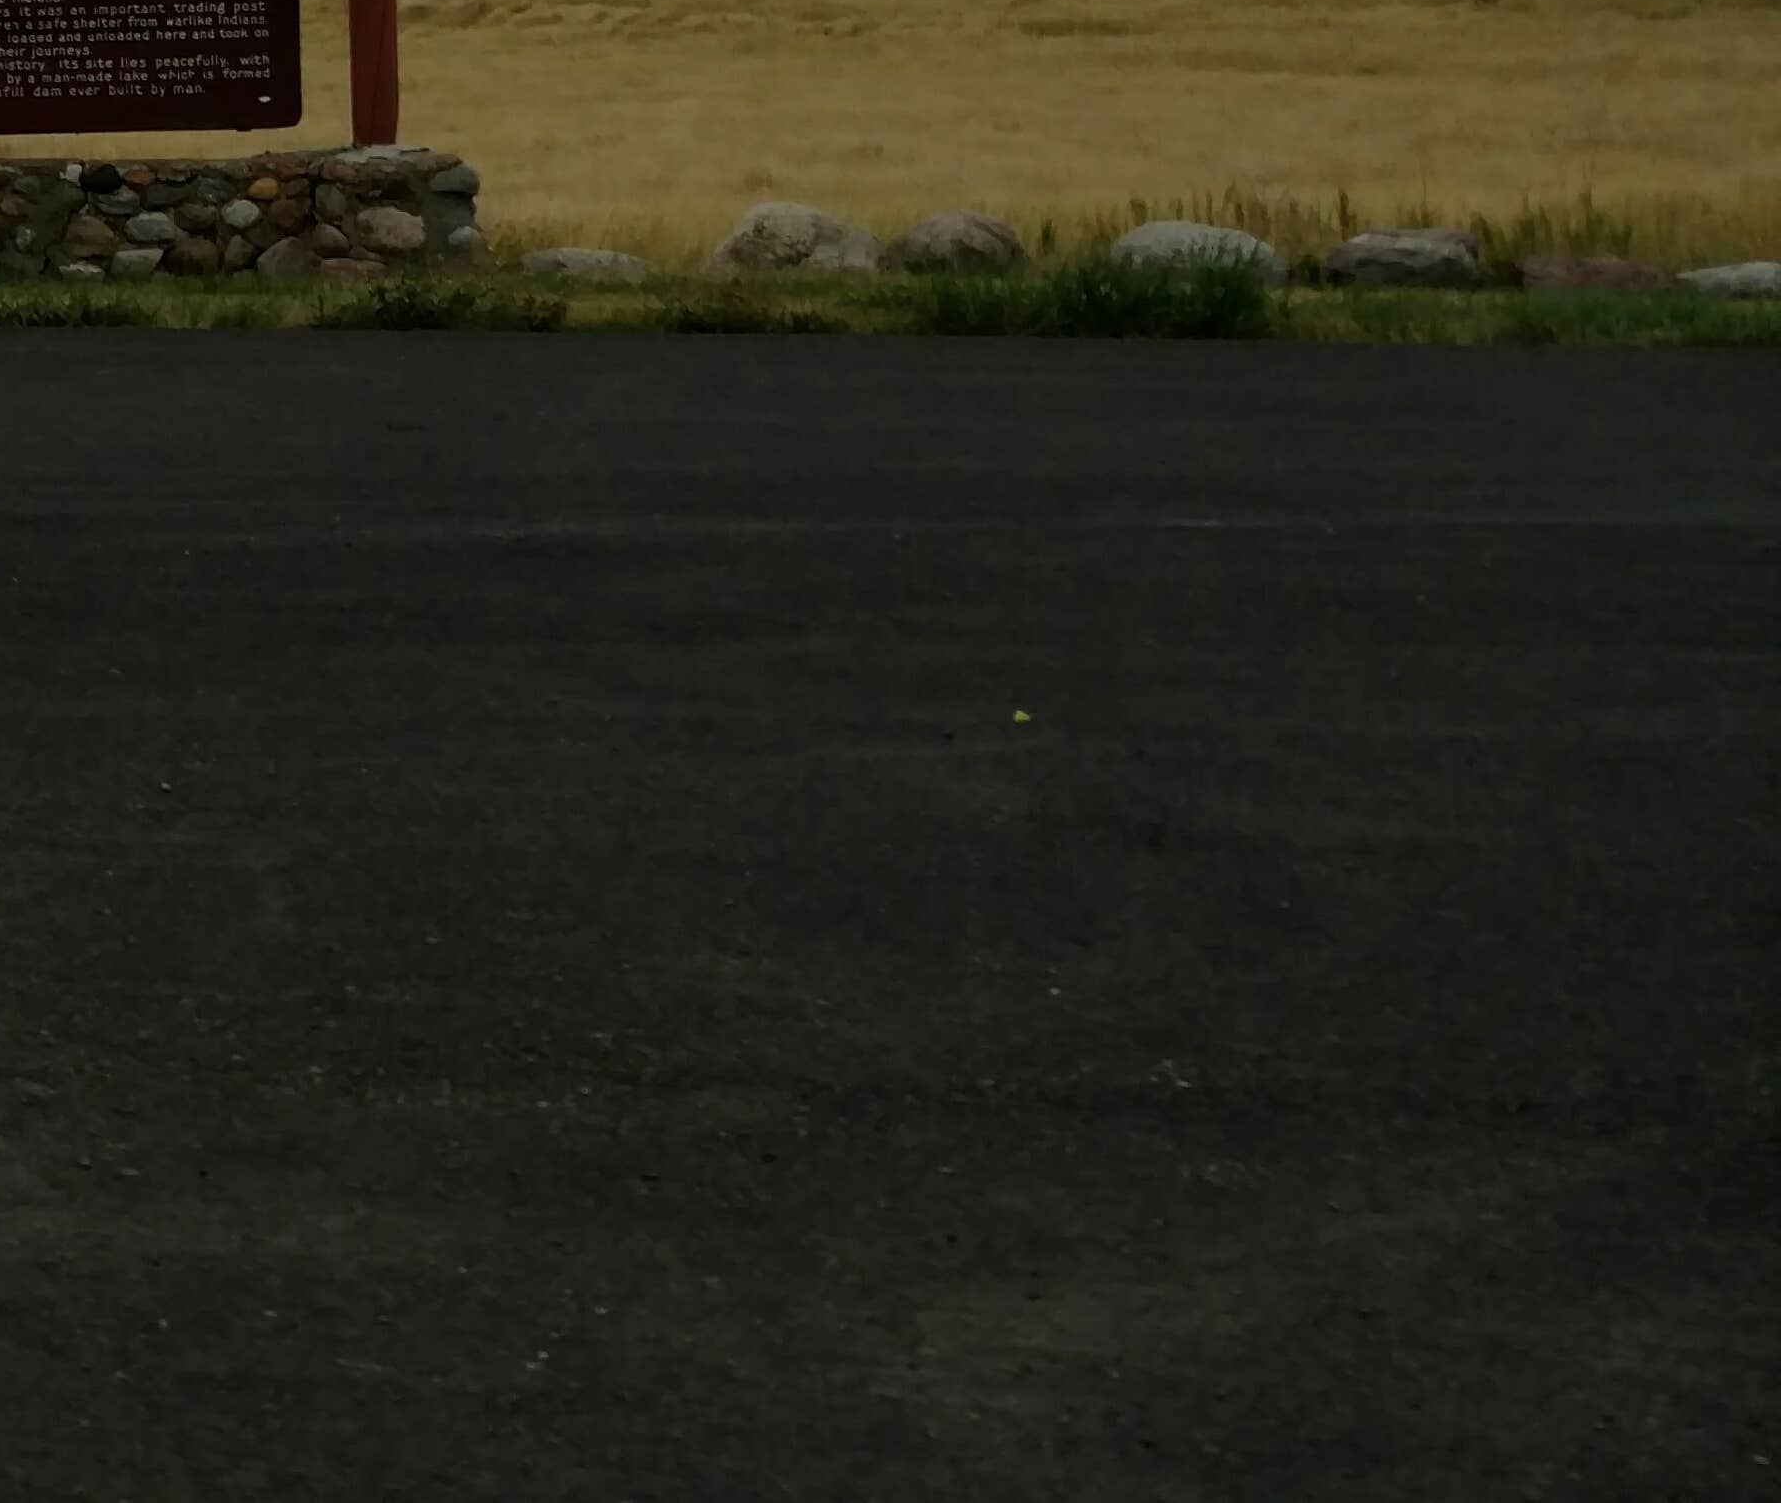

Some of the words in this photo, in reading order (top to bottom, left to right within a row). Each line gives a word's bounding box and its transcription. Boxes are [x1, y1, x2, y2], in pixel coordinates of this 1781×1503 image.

[37, 6, 62, 17] was
[70, 5, 86, 15] an
[94, 3, 166, 16] important
[174, 1, 226, 14] trading
[38, 19, 67, 29] safe
[73, 17, 122, 29] shelter
[128, 15, 157, 27] from
[166, 14, 213, 26] warlike
[58, 31, 81, 42] and
[88, 29, 150, 42] unloaded
[157, 29, 186, 40] here
[192, 27, 215, 39] and
[220, 26, 248, 38] took
[255, 27, 269, 37] on
[86, 57, 113, 68] site
[240, 54, 270, 66] with
[6, 72, 21, 85] by
[120, 68, 148, 81] lake
[203, 67, 213, 79] is
[222, 64, 270, 78] formed
[33, 83, 61, 98] dam
[69, 84, 100, 96] ever
[109, 82, 143, 96] built
[151, 82, 165, 97] by
